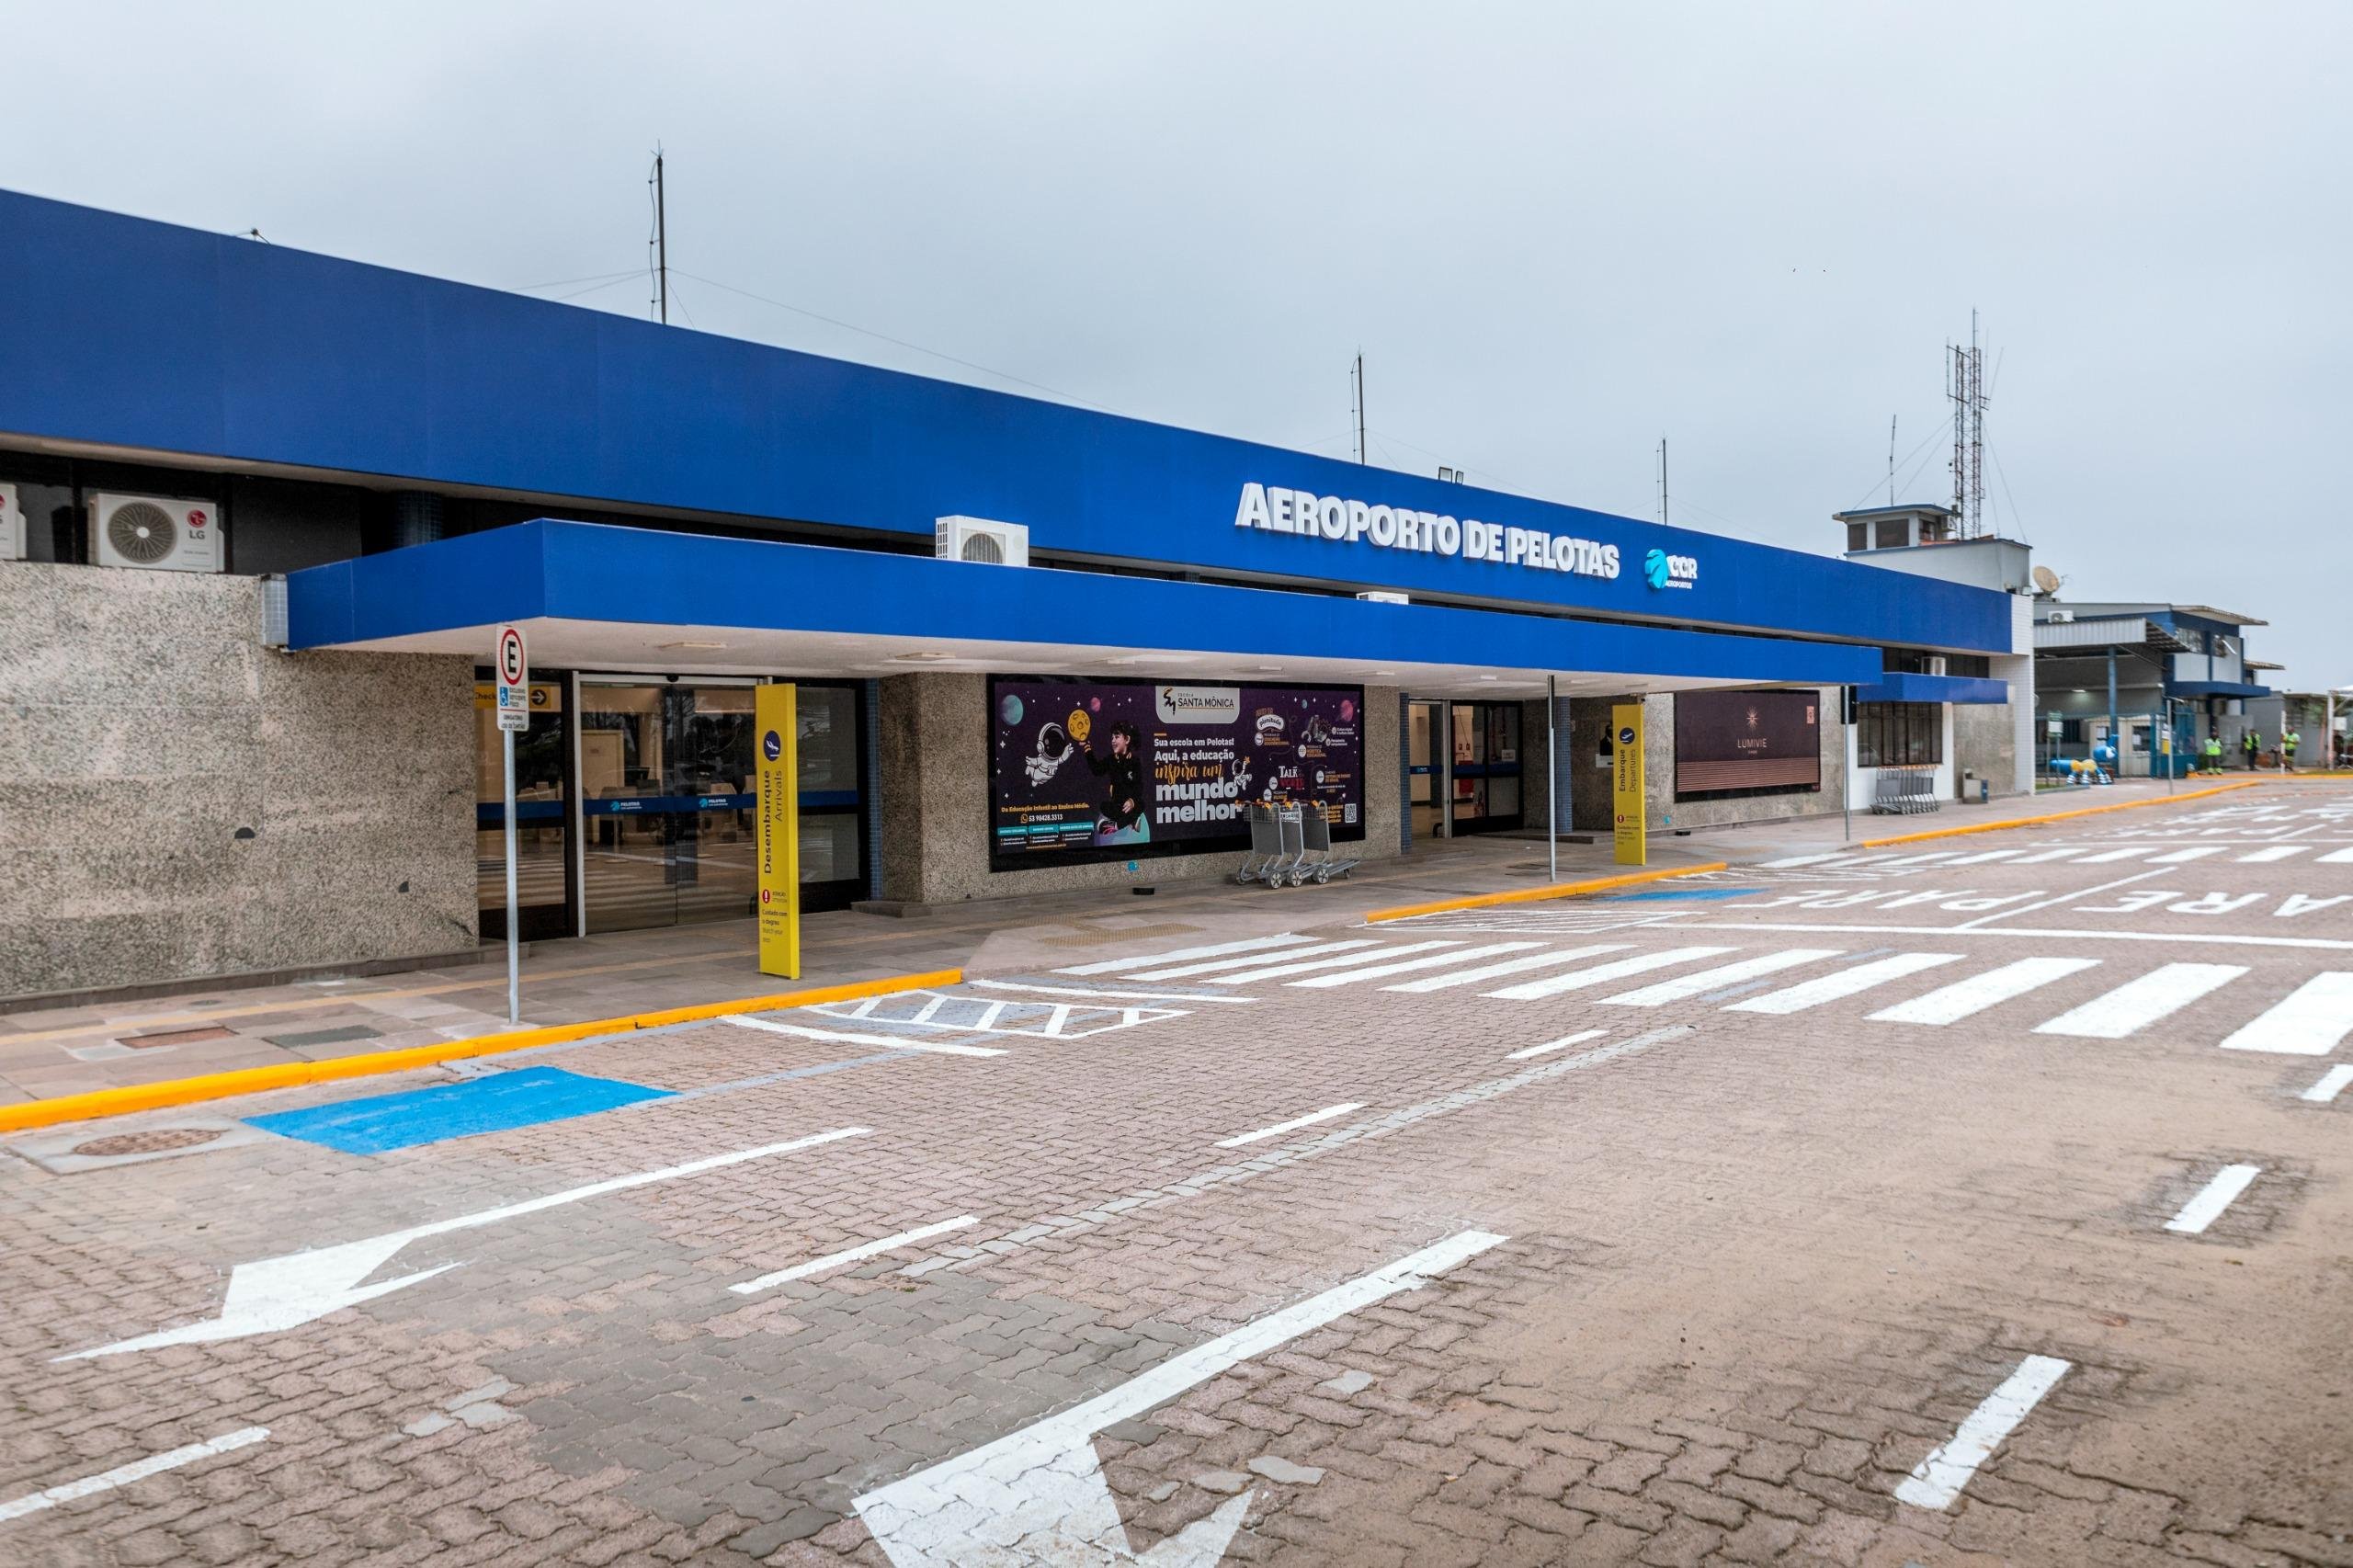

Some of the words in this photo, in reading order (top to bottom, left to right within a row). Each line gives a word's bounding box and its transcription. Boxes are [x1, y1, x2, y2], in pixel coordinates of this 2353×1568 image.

[189, 530, 205, 540] LG
[1235, 483, 1461, 556] AEROPORTO
[1462, 519, 1504, 562] DE
[1505, 527, 1620, 579] PELOTAS
[1666, 555, 1698, 579] CCR
[507, 640, 517, 674] E
[1177, 698, 1204, 707] SANTA
[1204, 696, 1234, 708] MÔNICA
[1154, 738, 1168, 746] Sua
[1169, 737, 1193, 746] escola
[1206, 737, 1234, 746] Pelotas!
[1737, 738, 1768, 748] LUMIVIE
[1154, 749, 1180, 763] Aqui,
[1182, 752, 1188, 760] a
[1189, 749, 1234, 763] educação
[1154, 762, 1198, 785] inspira
[1202, 763, 1222, 778] um
[1619, 749, 1627, 791] Embarque
[774, 770, 782, 822] Arrivals
[1155, 777, 1238, 801] mundo
[764, 770, 772, 874] Desembarque
[1156, 799, 1242, 824] melhor
[1722, 889, 2048, 912] PARE
[2072, 890, 2353, 918] ARE
